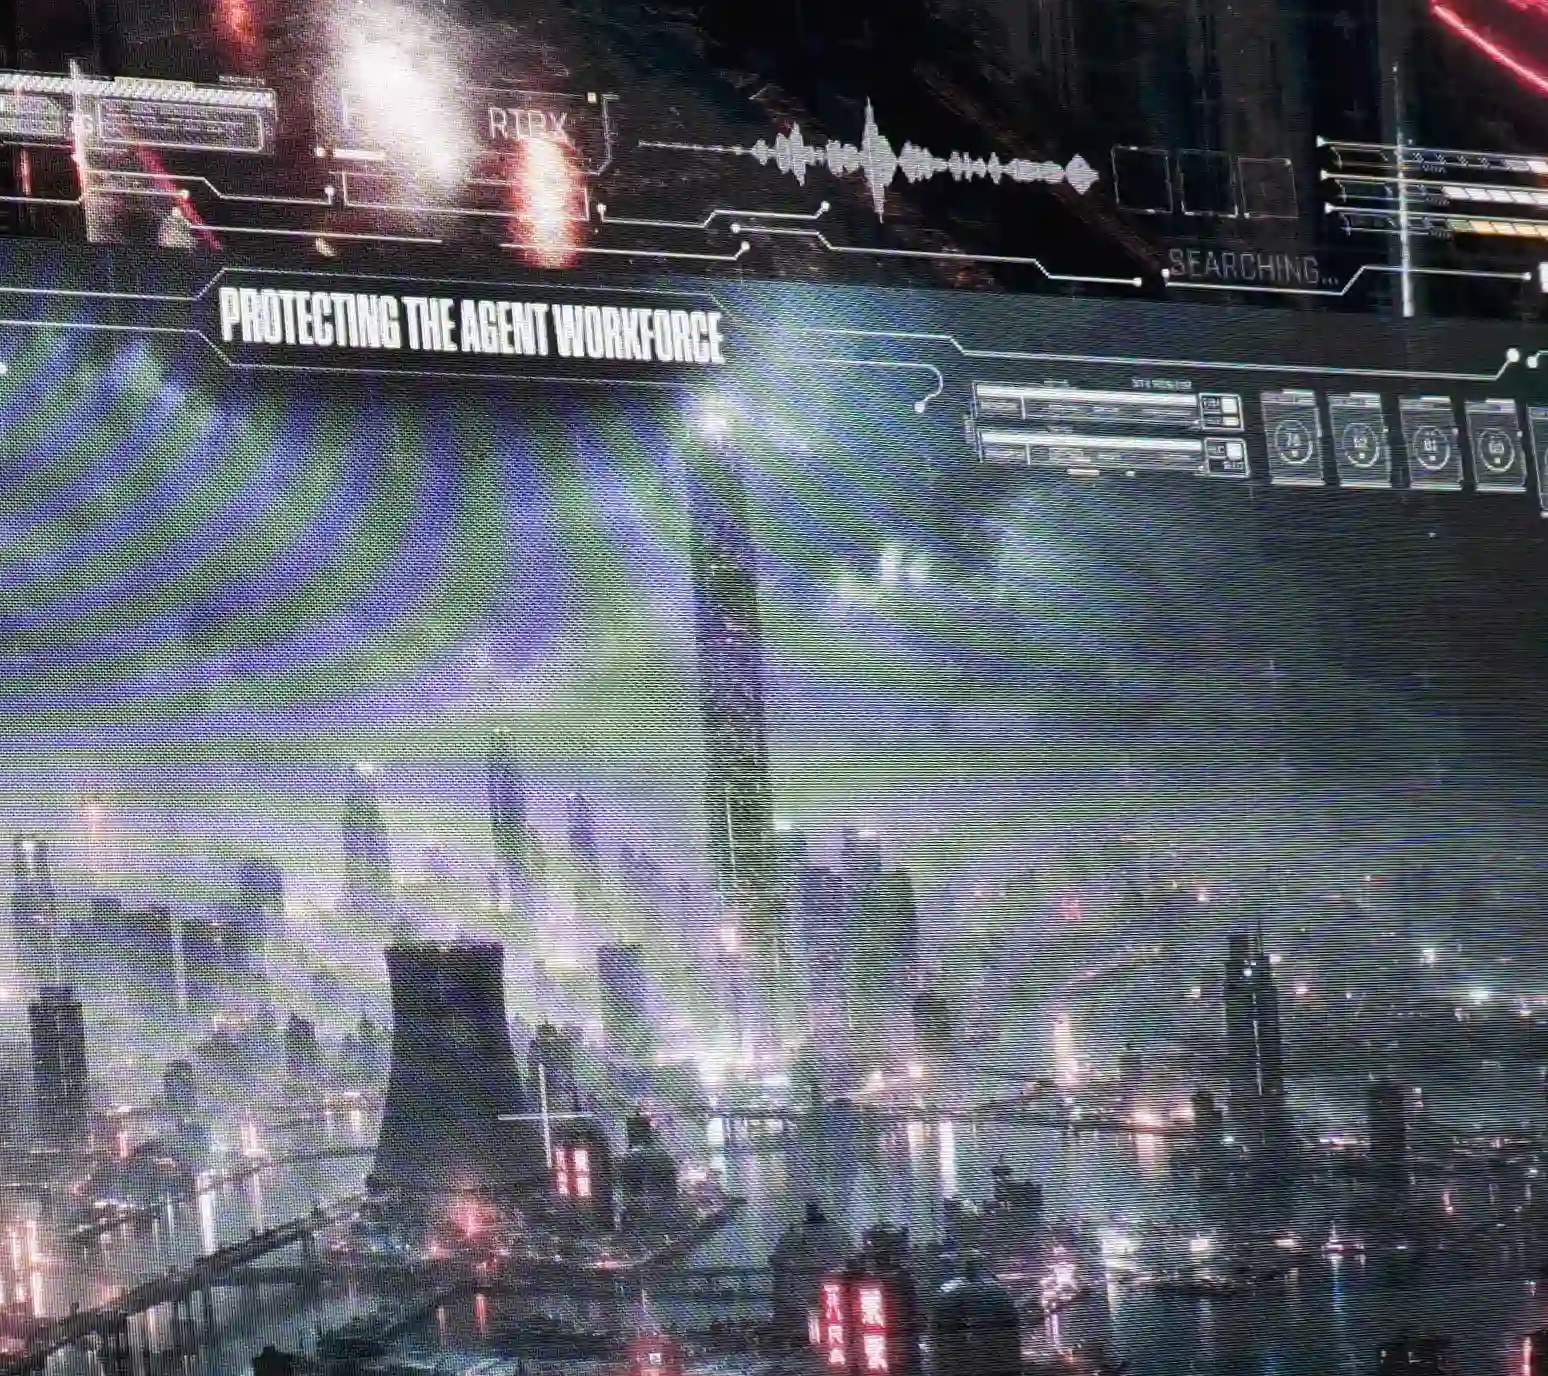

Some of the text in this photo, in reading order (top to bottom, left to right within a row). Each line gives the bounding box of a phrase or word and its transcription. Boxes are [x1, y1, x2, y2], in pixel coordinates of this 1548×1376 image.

[1168, 245, 1341, 289] SEARCHING...
[219, 286, 726, 364] PROTECTING THE AGENT WORKFORCE
